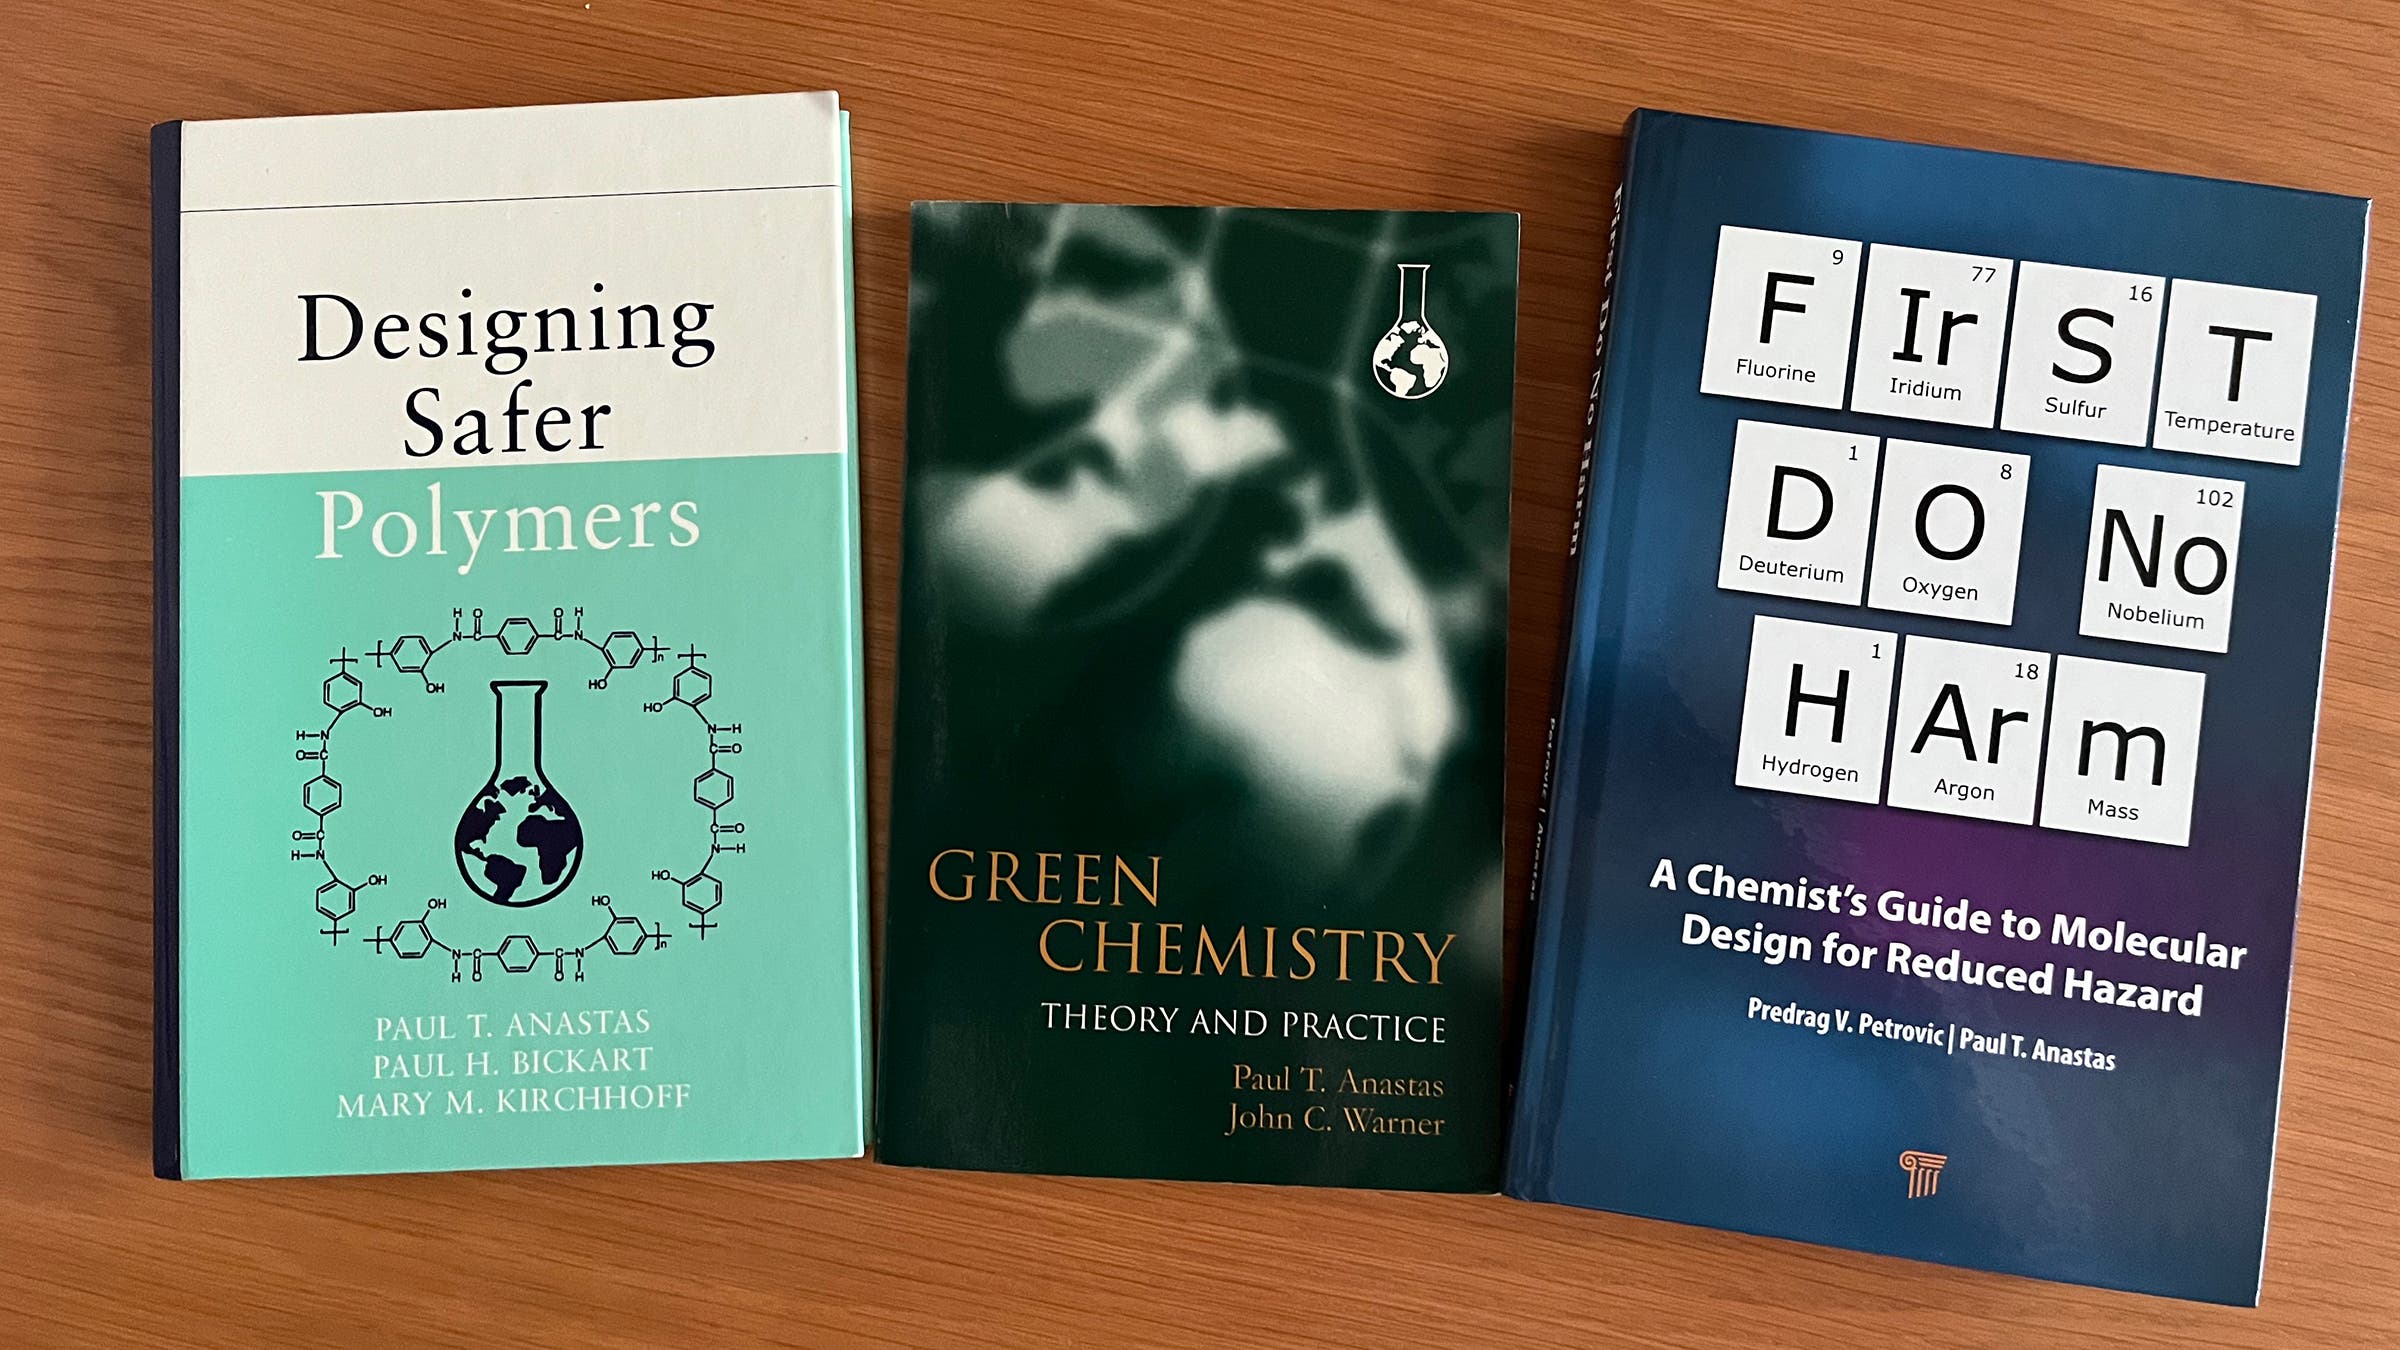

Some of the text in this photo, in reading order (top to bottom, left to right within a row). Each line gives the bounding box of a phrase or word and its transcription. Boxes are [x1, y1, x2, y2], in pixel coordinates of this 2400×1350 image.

[1832, 250, 1845, 265] 9
[1971, 267, 1996, 283] 77
[2129, 285, 2153, 303] 16
[298, 283, 715, 375] Designing
[1569, 184, 1623, 558] First Do No Harm
[1736, 359, 1817, 384] Fluorine
[1889, 378, 1963, 402] Iridium
[404, 379, 611, 457] Safer
[2045, 397, 2108, 420] Sulfur
[2165, 411, 2295, 441] Temperature
[1848, 445, 1858, 460] 1
[2000, 464, 2013, 480] 8
[2197, 489, 2234, 508] 102
[315, 482, 700, 575] Polymers
[1739, 555, 1845, 583] Deuterium
[1902, 578, 1979, 601] Oxygen
[2108, 603, 2206, 630] Nobelium
[1871, 644, 1881, 659] 1
[2015, 663, 2040, 680] 18
[1762, 754, 1859, 784] Hydrogen
[1934, 779, 1996, 802] Argon
[2088, 800, 2140, 821] Mass
[928, 849, 1162, 908] GREEN
[1649, 858, 2248, 972] A Chemist’s Guide to Molecular
[1039, 919, 1456, 985] CHEMISTRY
[1680, 914, 2204, 1018] Design for Reduced Hazard
[375, 1009, 651, 1041] PAUL T. ANASTAS
[1042, 1003, 1446, 1043] THEORY AND PRACTICE
[1748, 998, 1830, 1034] Predrag
[1834, 1010, 1854, 1034] V.
[1858, 1013, 1944, 1047] Petrovic
[1960, 1028, 2006, 1056] Paul
[2010, 1033, 2028, 1058] T.
[2032, 1038, 2116, 1072] Anastas
[374, 1046, 653, 1079] PAUL H. BICKART
[1234, 1064, 1445, 1098] Paul T. Anastas
[337, 1084, 691, 1118] MARY M. KIRCHHOFF
[1225, 1103, 1445, 1136] John C. Warner
